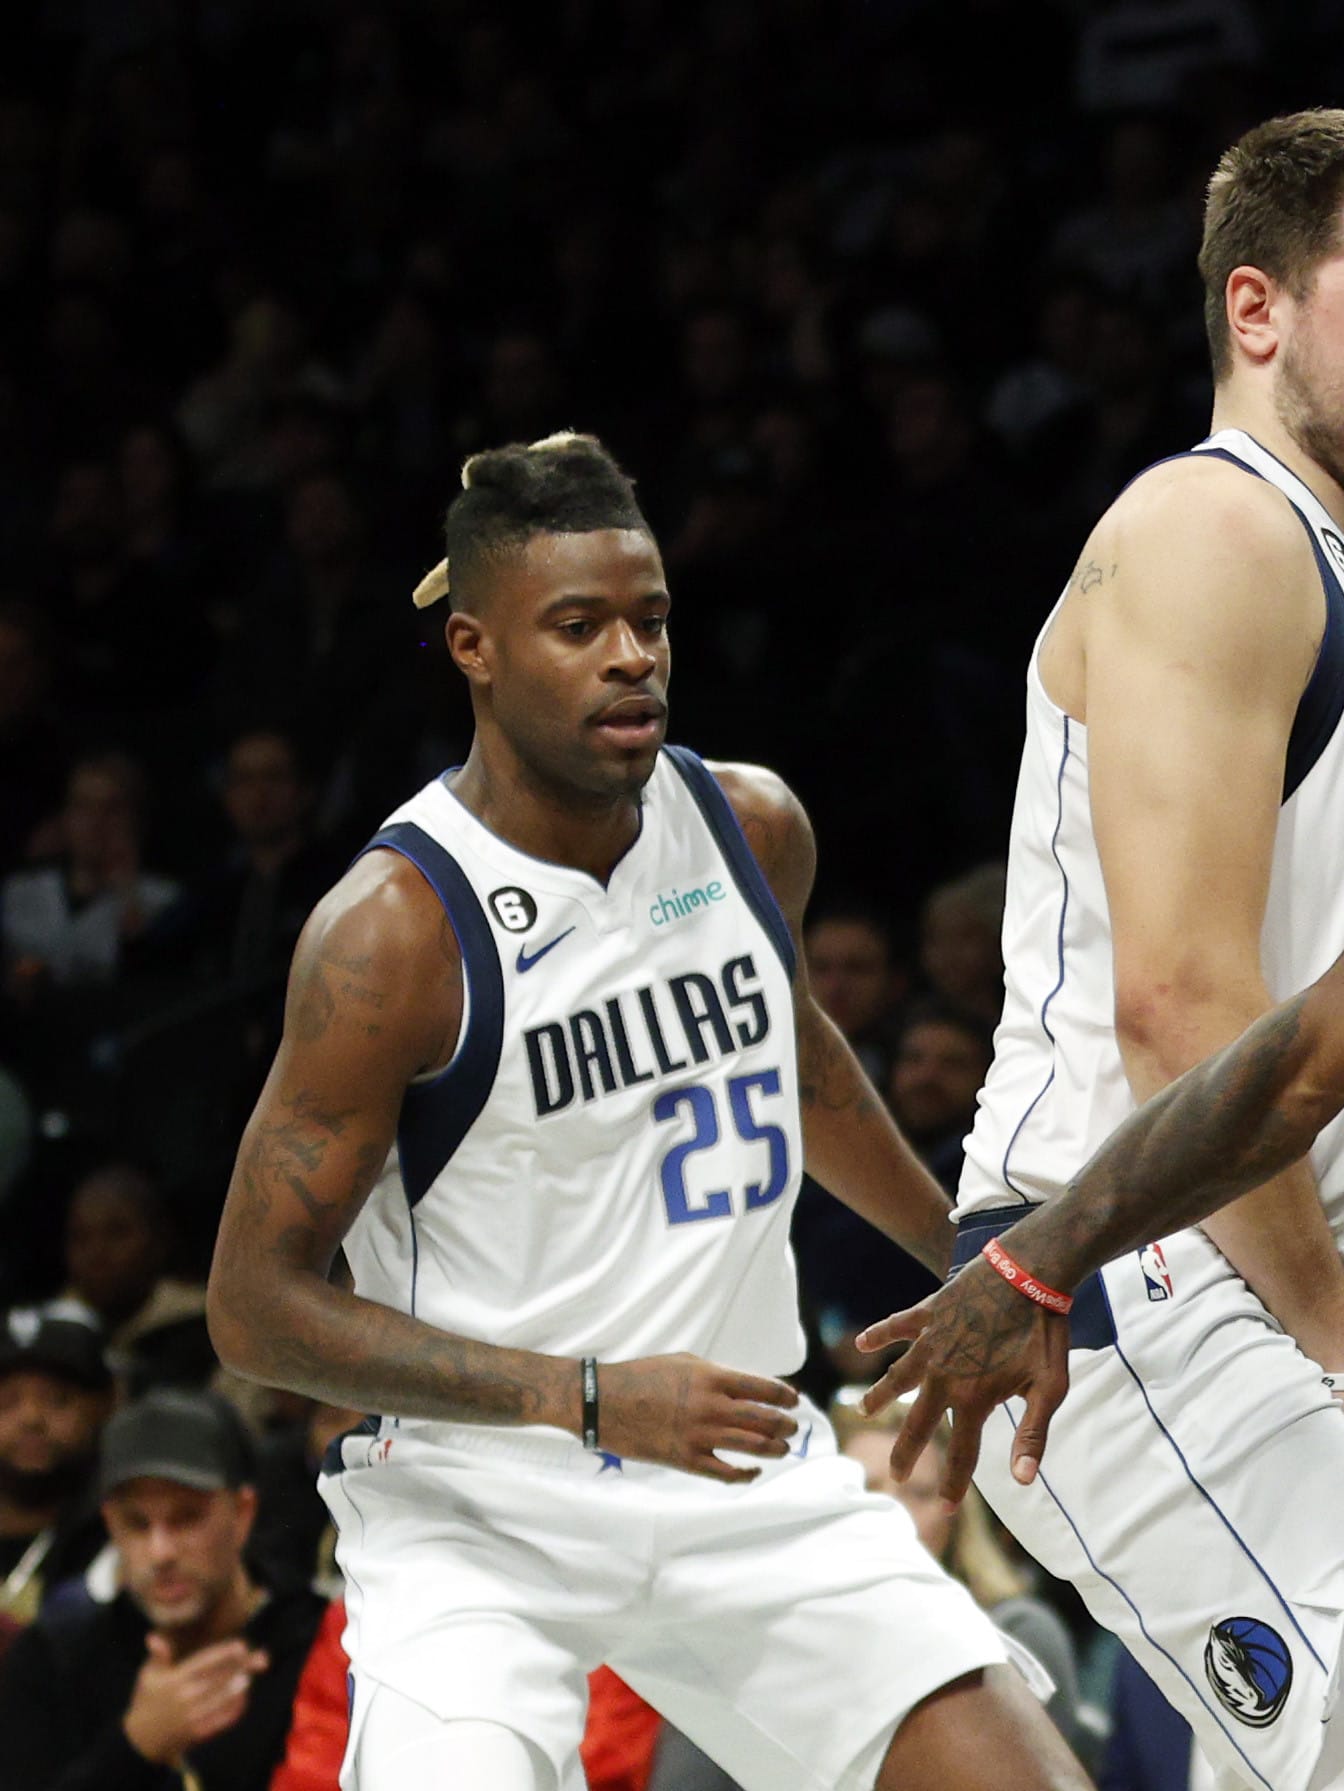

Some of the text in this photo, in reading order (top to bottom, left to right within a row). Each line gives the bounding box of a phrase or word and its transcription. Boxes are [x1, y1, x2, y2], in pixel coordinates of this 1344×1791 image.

[493, 891, 529, 930] 6
[649, 881, 727, 926] chime
[522, 954, 770, 1121] DALLAS
[652, 1066, 790, 1227] 25
